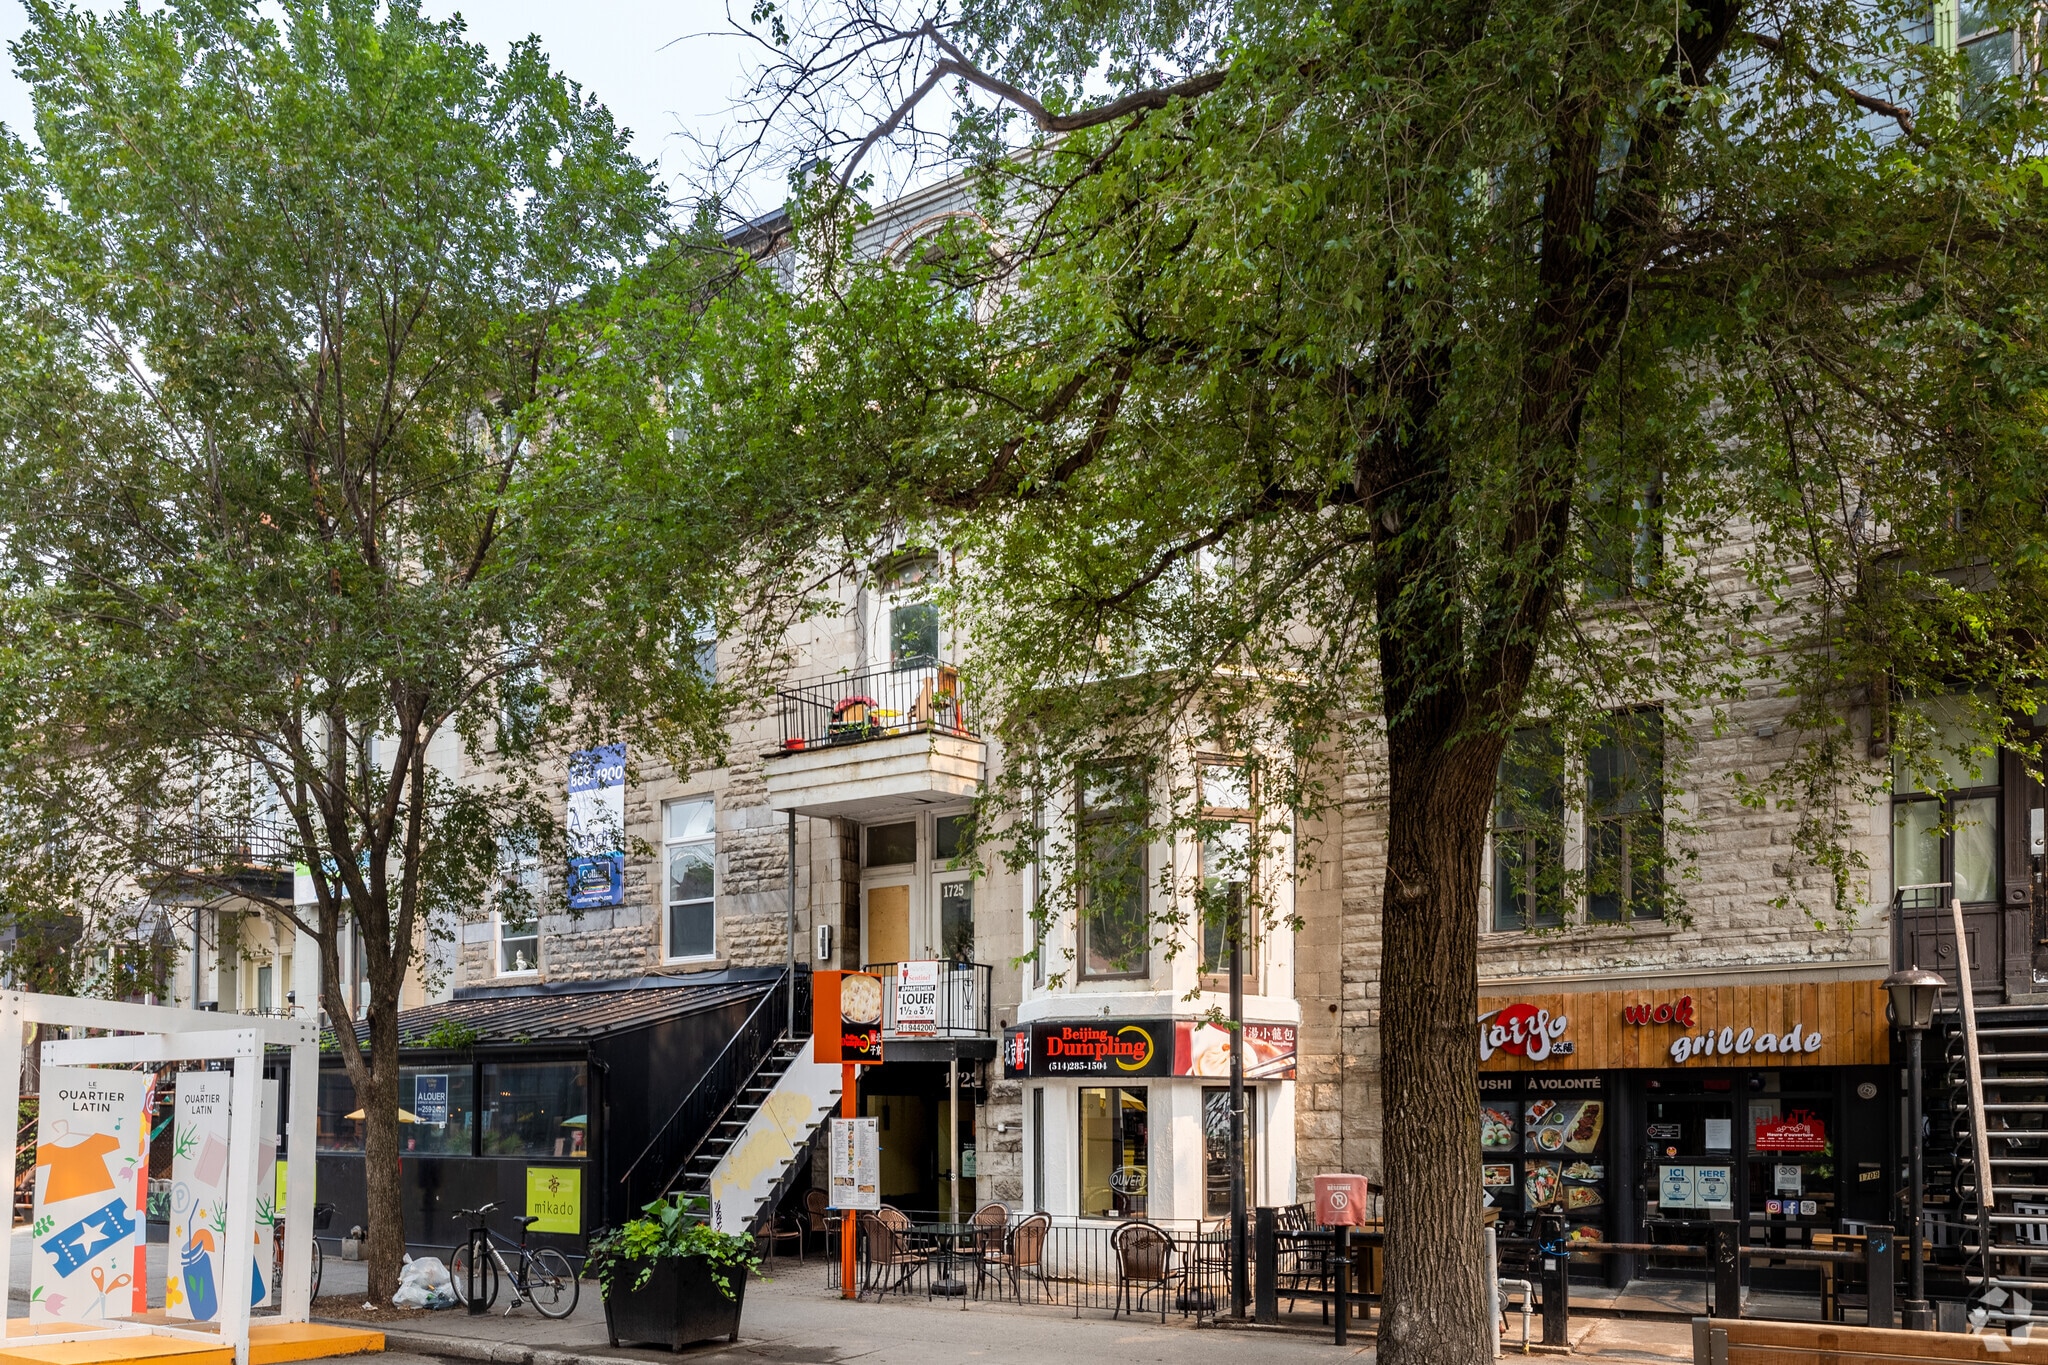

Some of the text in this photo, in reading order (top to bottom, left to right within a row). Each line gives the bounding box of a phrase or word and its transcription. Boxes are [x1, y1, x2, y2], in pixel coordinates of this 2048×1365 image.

[943, 884, 965, 898] 1725
[902, 993, 935, 1005] LOUER
[1624, 995, 1696, 1028] wok
[1062, 1027, 1108, 1042] Beijing
[1477, 1009, 1567, 1061] Taiyo
[1047, 1036, 1146, 1061] Dumpling
[1670, 1024, 1822, 1064] grillade
[1048, 1061, 1108, 1072] (514)285-1504
[1478, 1079, 1512, 1090] USHI
[1528, 1076, 1601, 1089] À VOLONTÉ
[58, 1089, 125, 1102] QUARTIER
[184, 1093, 221, 1104] QUARTIER
[423, 1092, 445, 1101] LOUER
[72, 1101, 111, 1113] LATIN
[191, 1104, 213, 1115] LATIN
[1669, 1168, 1684, 1177] ICI
[1699, 1170, 1726, 1178] HERE
[1861, 1172, 1879, 1180] 1709
[1112, 1175, 1146, 1187] OUVERT
[534, 1200, 574, 1216] mikado
